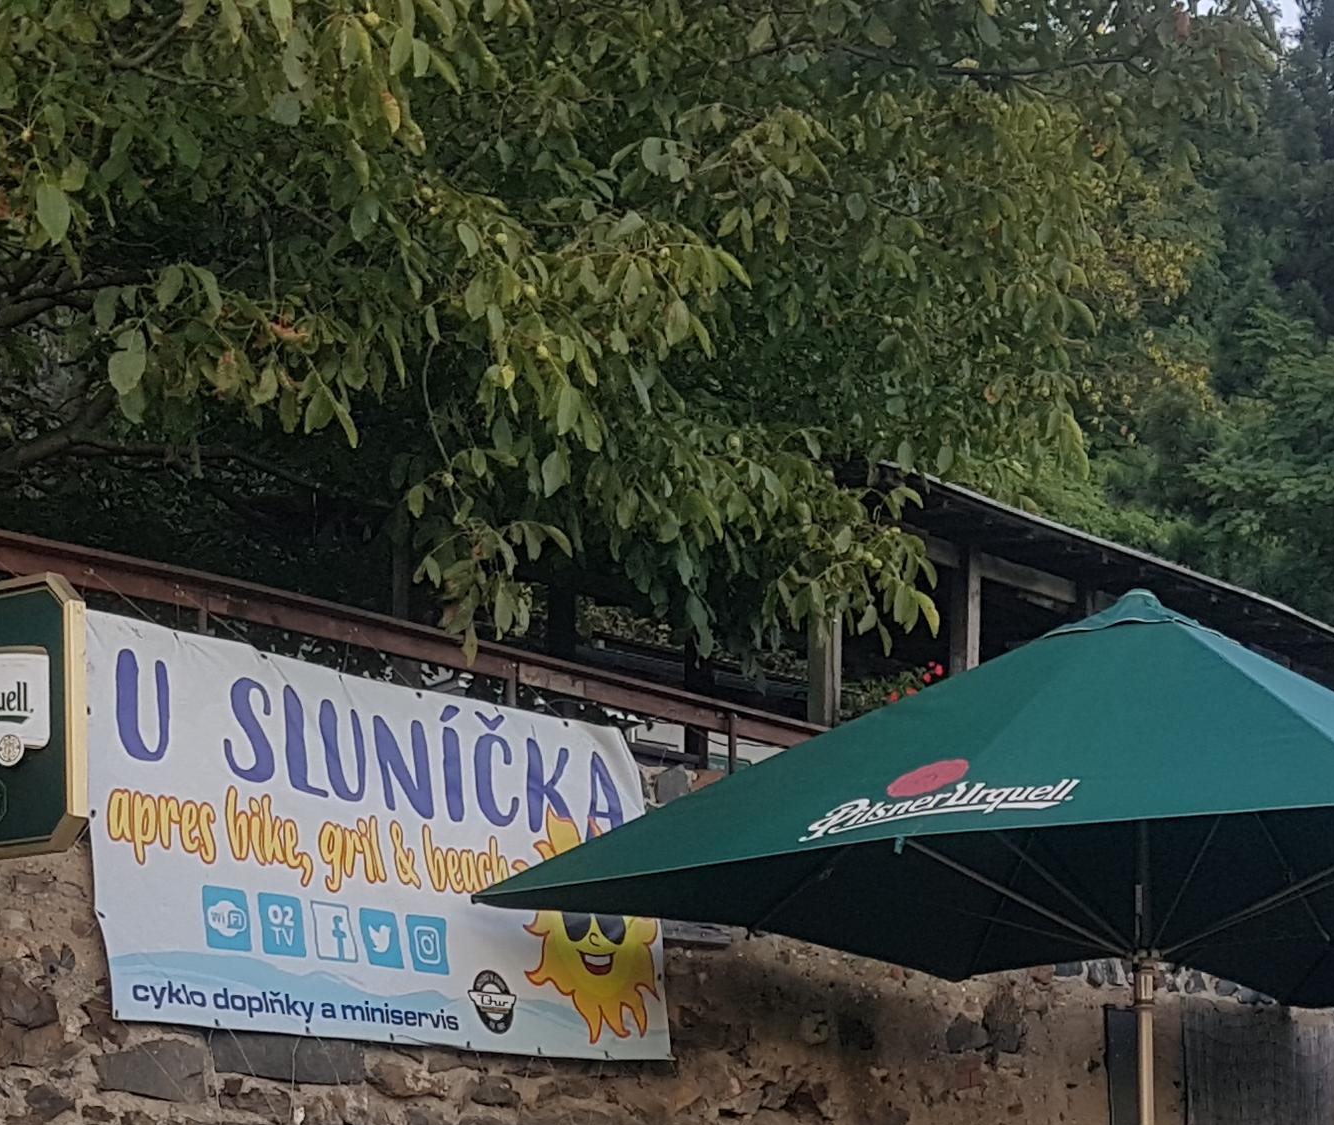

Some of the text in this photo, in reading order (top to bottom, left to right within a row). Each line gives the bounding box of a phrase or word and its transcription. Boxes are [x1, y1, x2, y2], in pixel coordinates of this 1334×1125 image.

[115, 648, 624, 842] U SLUNÍČKA
[107, 785, 510, 894] apres bike, gril & beach
[798, 792, 952, 842] Pilsner
[270, 927, 295, 947] TV
[132, 981, 460, 1032] cyklo doplňky a miniservis
